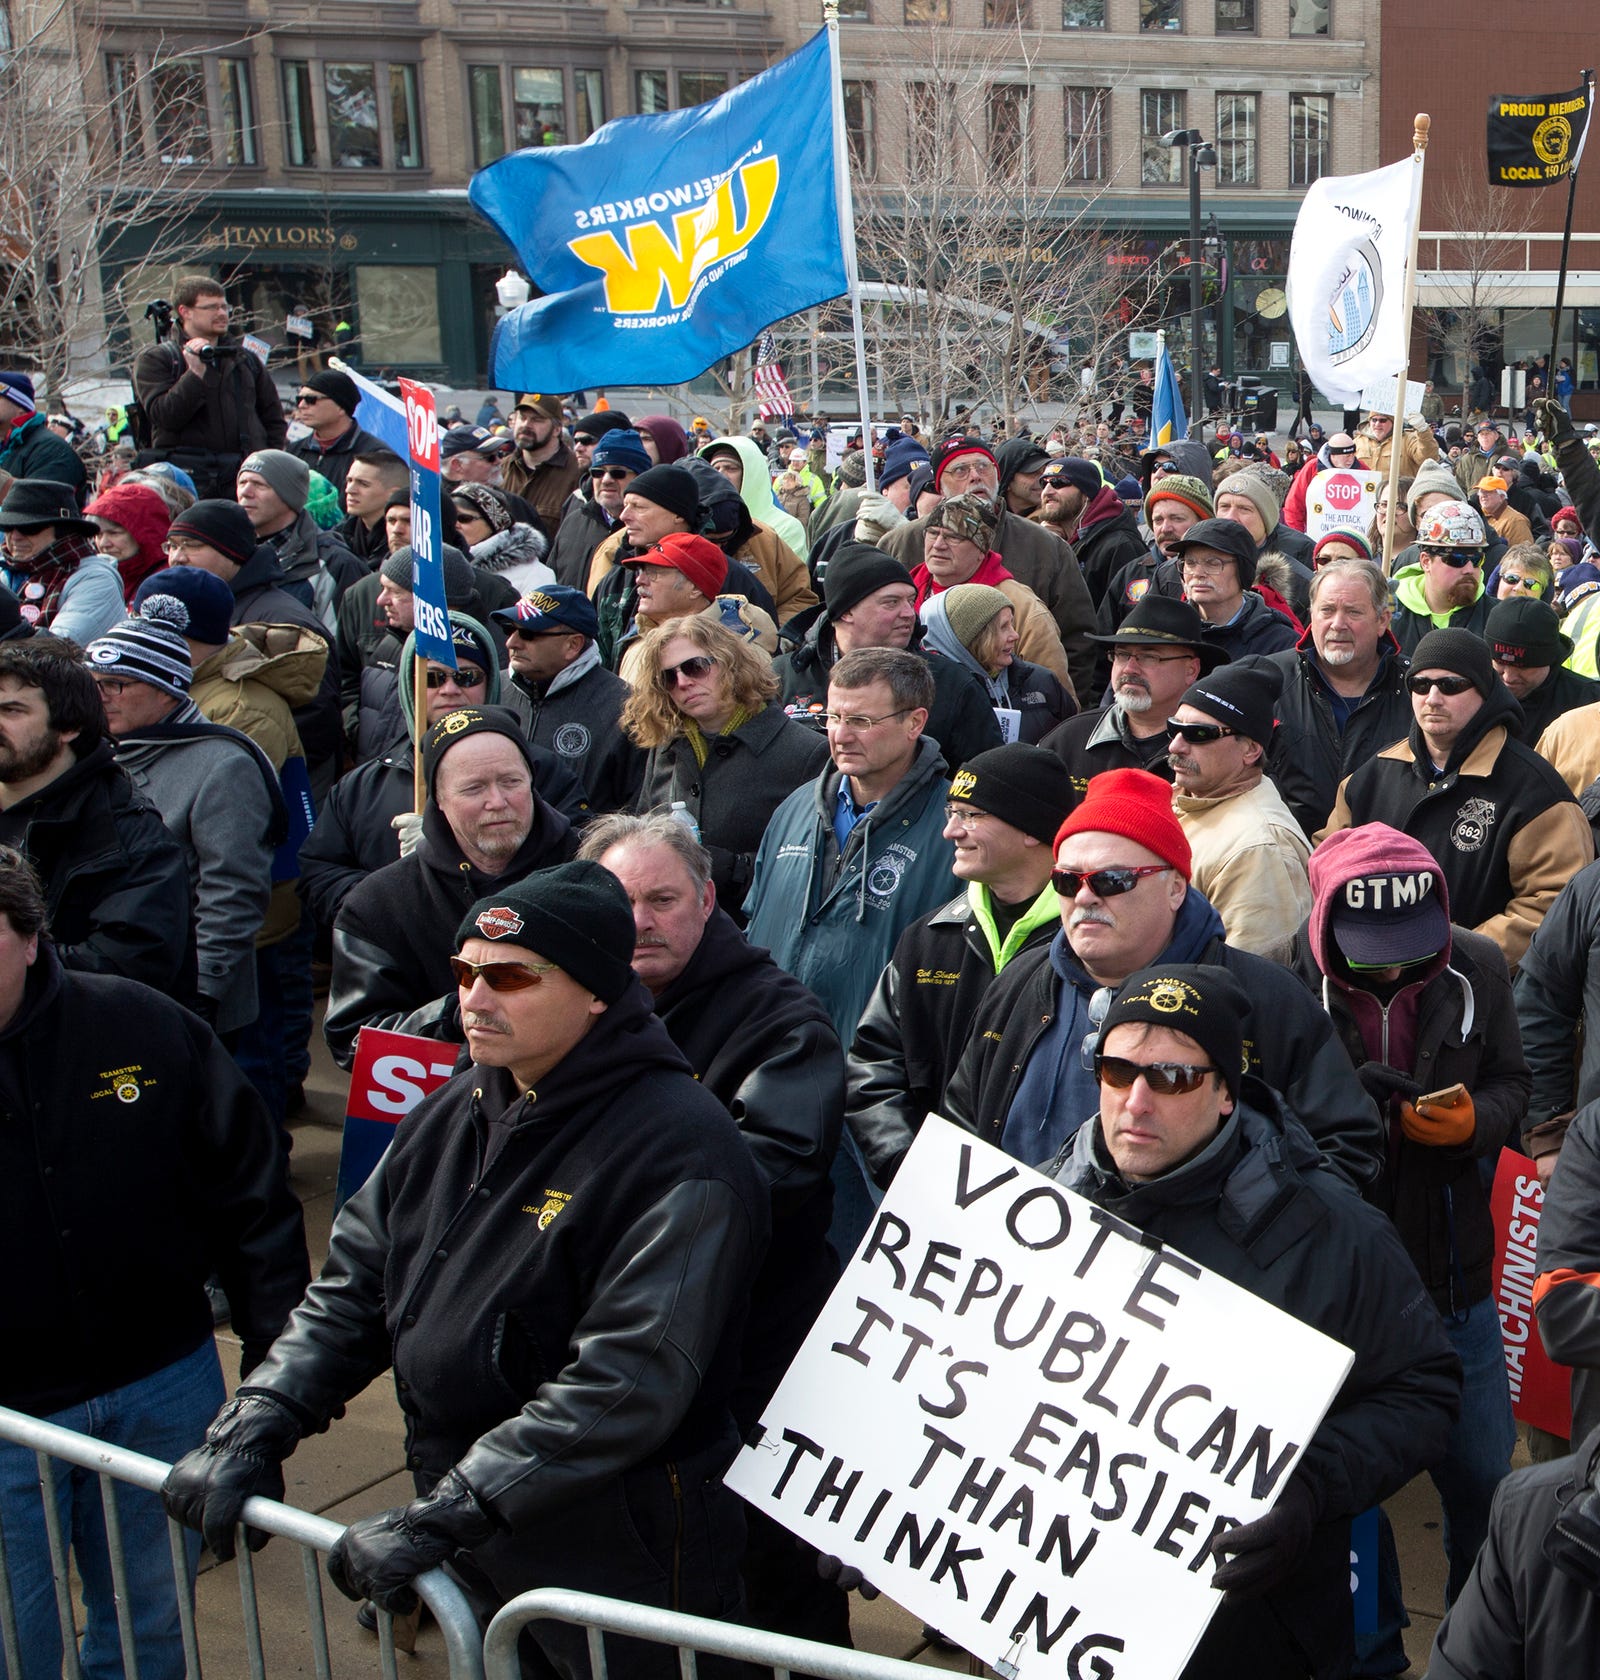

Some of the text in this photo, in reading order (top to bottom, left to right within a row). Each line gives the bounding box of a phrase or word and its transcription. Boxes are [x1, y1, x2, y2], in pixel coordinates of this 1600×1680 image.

[1500, 96, 1585, 117] PROUD MEMBERS
[1501, 166, 1542, 180] LOCAL
[1544, 164, 1559, 178] 150
[406, 395, 438, 460] SOP
[1326, 483, 1360, 500] STOP
[1325, 513, 1361, 524] THE ATTACK
[92, 648, 120, 664] G
[1494, 643, 1526, 657] IBEW
[433, 709, 479, 731] TEAMSTERS
[1459, 824, 1480, 840] 662
[887, 842, 918, 863] AMSTERS
[1142, 977, 1202, 1001] TEAMSTERS
[99, 1064, 142, 1079] TEAMSTERS
[90, 1088, 115, 1100] LOCAL
[955, 1143, 1202, 1331] VOTE
[1502, 1173, 1545, 1404] MACHINISTS
[831, 1296, 988, 1419] IT'S
[861, 1211, 1299, 1500] REPUBLICAN
[1010, 1402, 1243, 1573] EASIER
[908, 1423, 1100, 1578] THAN
[771, 1428, 1126, 1680] THINKING
